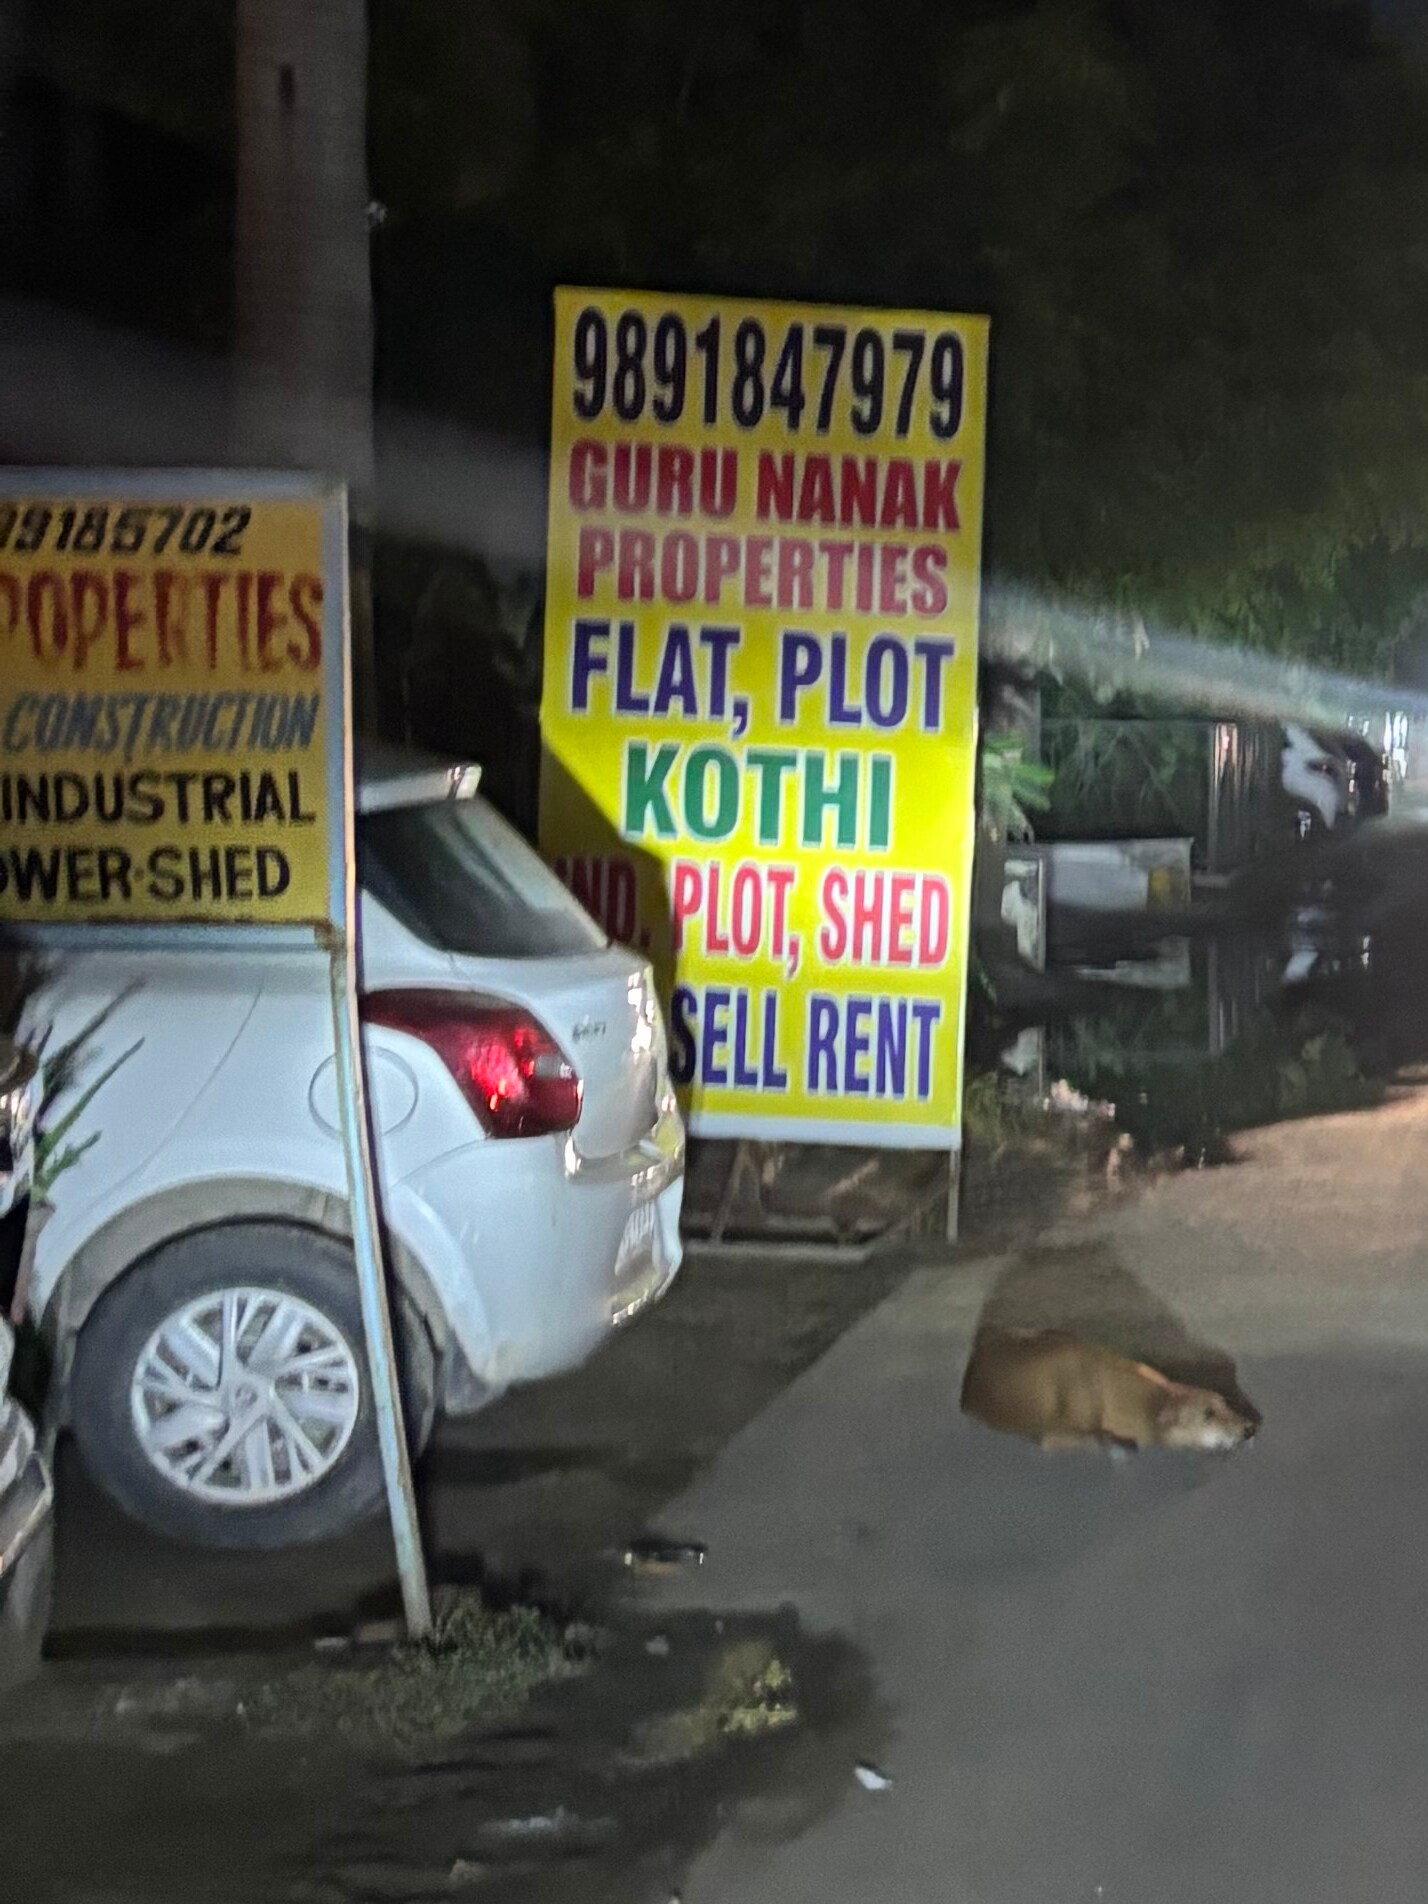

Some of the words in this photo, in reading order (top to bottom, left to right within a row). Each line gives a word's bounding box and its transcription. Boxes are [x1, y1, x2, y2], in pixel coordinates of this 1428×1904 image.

[572, 307, 965, 437] 9891847979
[568, 441, 738, 520] GURU
[756, 451, 962, 530] NANAK
[577, 527, 948, 616] PROPERTIES
[5, 690, 319, 764] CONSTRUCTION
[571, 621, 750, 738] FLAT,
[779, 632, 956, 730] PLOT
[2, 771, 316, 826] INDUSTRIAL
[625, 746, 894, 851] KOTHI
[672, 861, 799, 976] PLOT,
[820, 872, 950, 967] SHED
[668, 985, 788, 1091] SELL
[807, 992, 941, 1098] RENT
